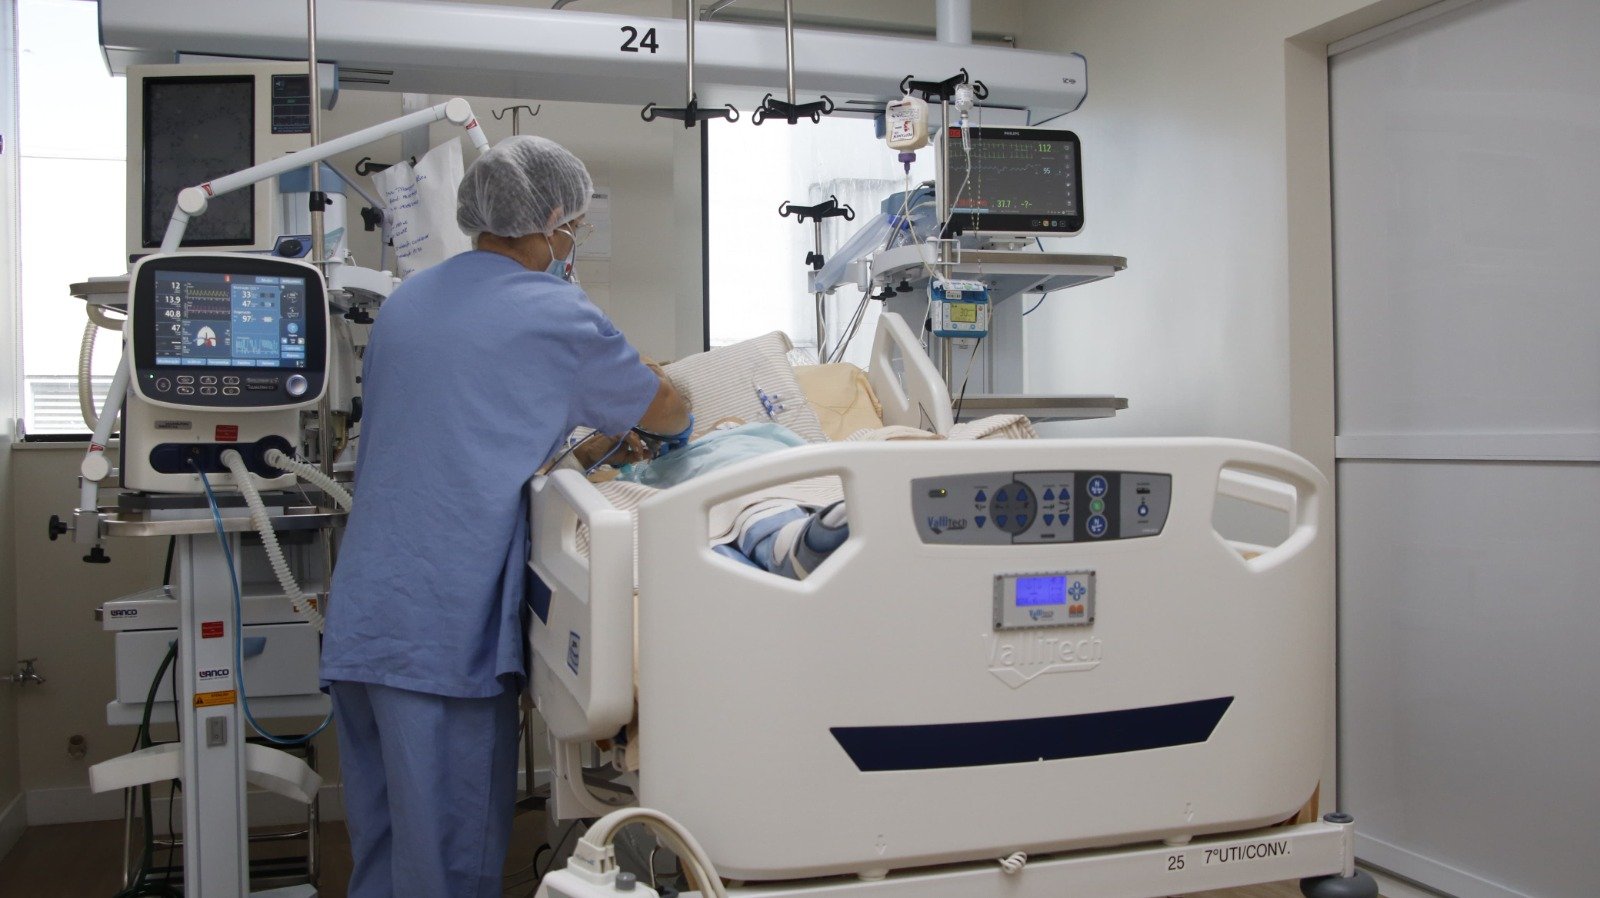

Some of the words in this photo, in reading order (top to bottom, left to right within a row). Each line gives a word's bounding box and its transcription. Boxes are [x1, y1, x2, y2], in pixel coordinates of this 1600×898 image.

[620, 26, 659, 53] 24
[1038, 143, 1052, 152] 112
[997, 200, 1012, 208] 37.7
[242, 291, 252, 299] 33
[242, 315, 252, 323] 97
[1204, 841, 1291, 864] 7°UTI/CONV.
[1167, 855, 1185, 870] 25
